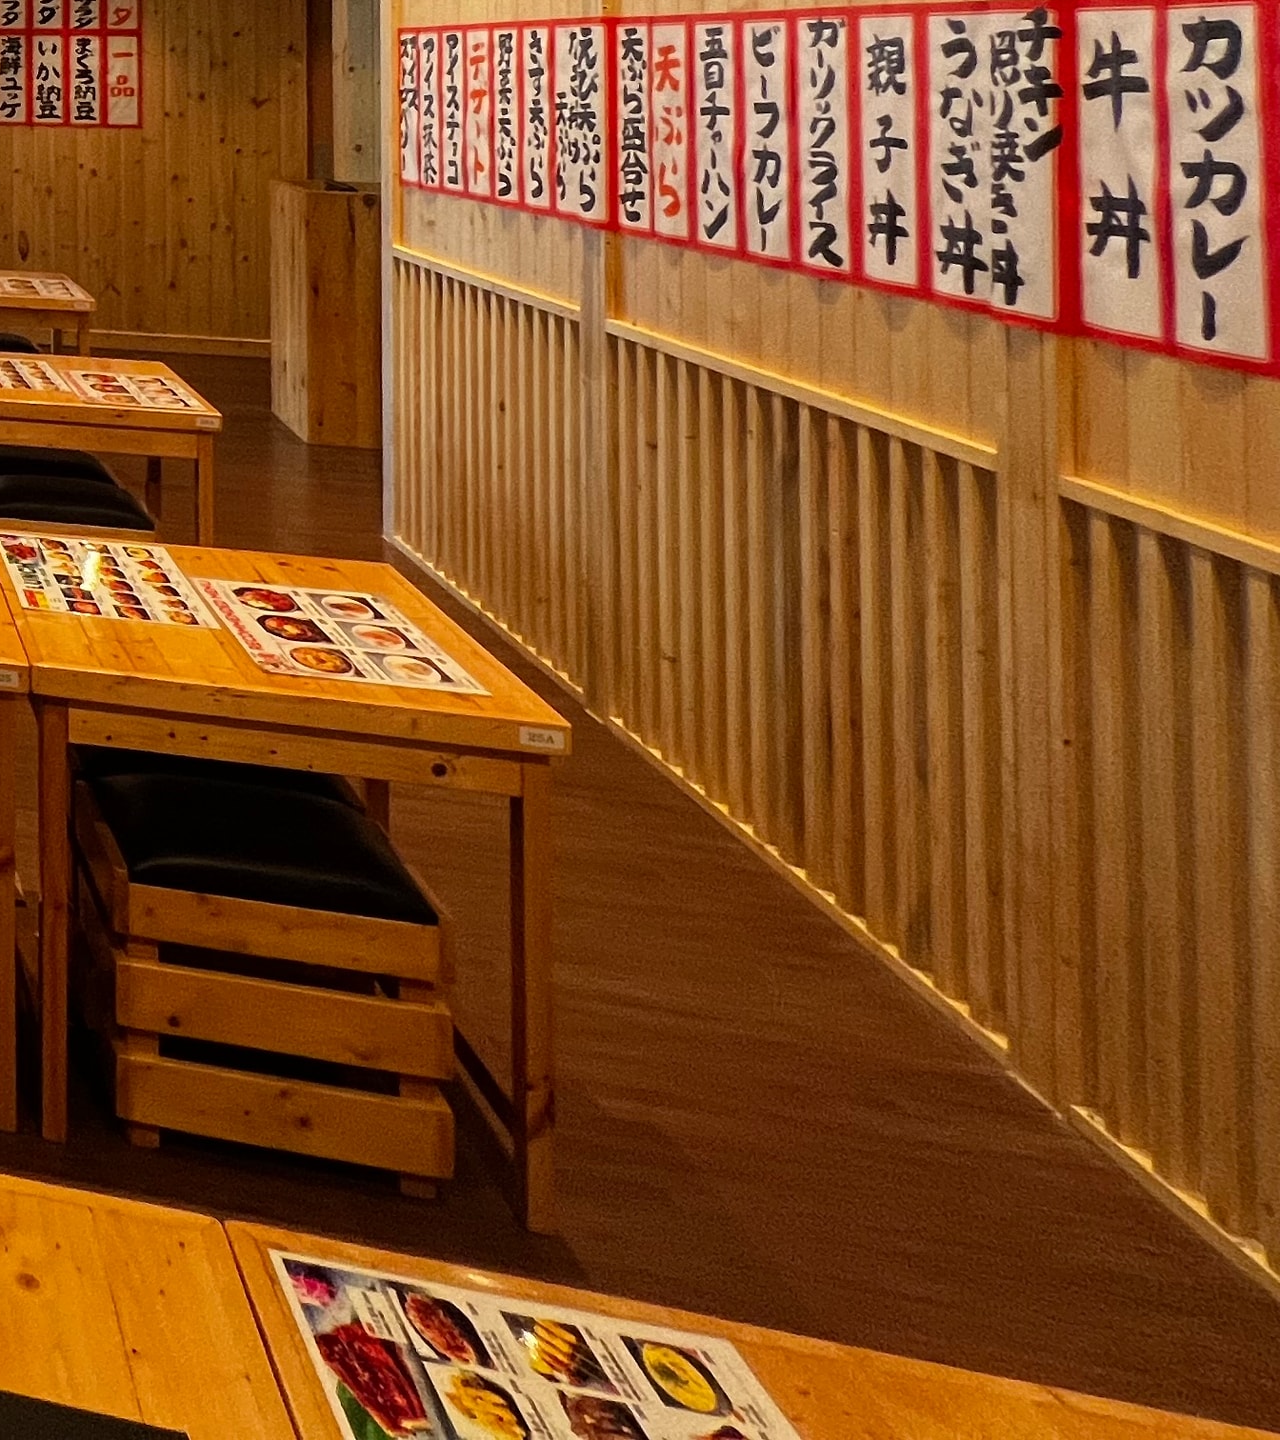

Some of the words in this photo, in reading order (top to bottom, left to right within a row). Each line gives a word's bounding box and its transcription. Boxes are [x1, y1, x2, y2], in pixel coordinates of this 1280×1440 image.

[35, 40, 61, 119] いか納豆
[654, 43, 683, 218] 天ぷら
[751, 24, 784, 252] ビーフカレー
[805, 16, 846, 268] ガーリックライス
[865, 33, 910, 266] 親子丼
[935, 17, 989, 296] うなぎ丼
[1082, 30, 1151, 280] 牛丼
[1176, 14, 1251, 342] カツカレー
